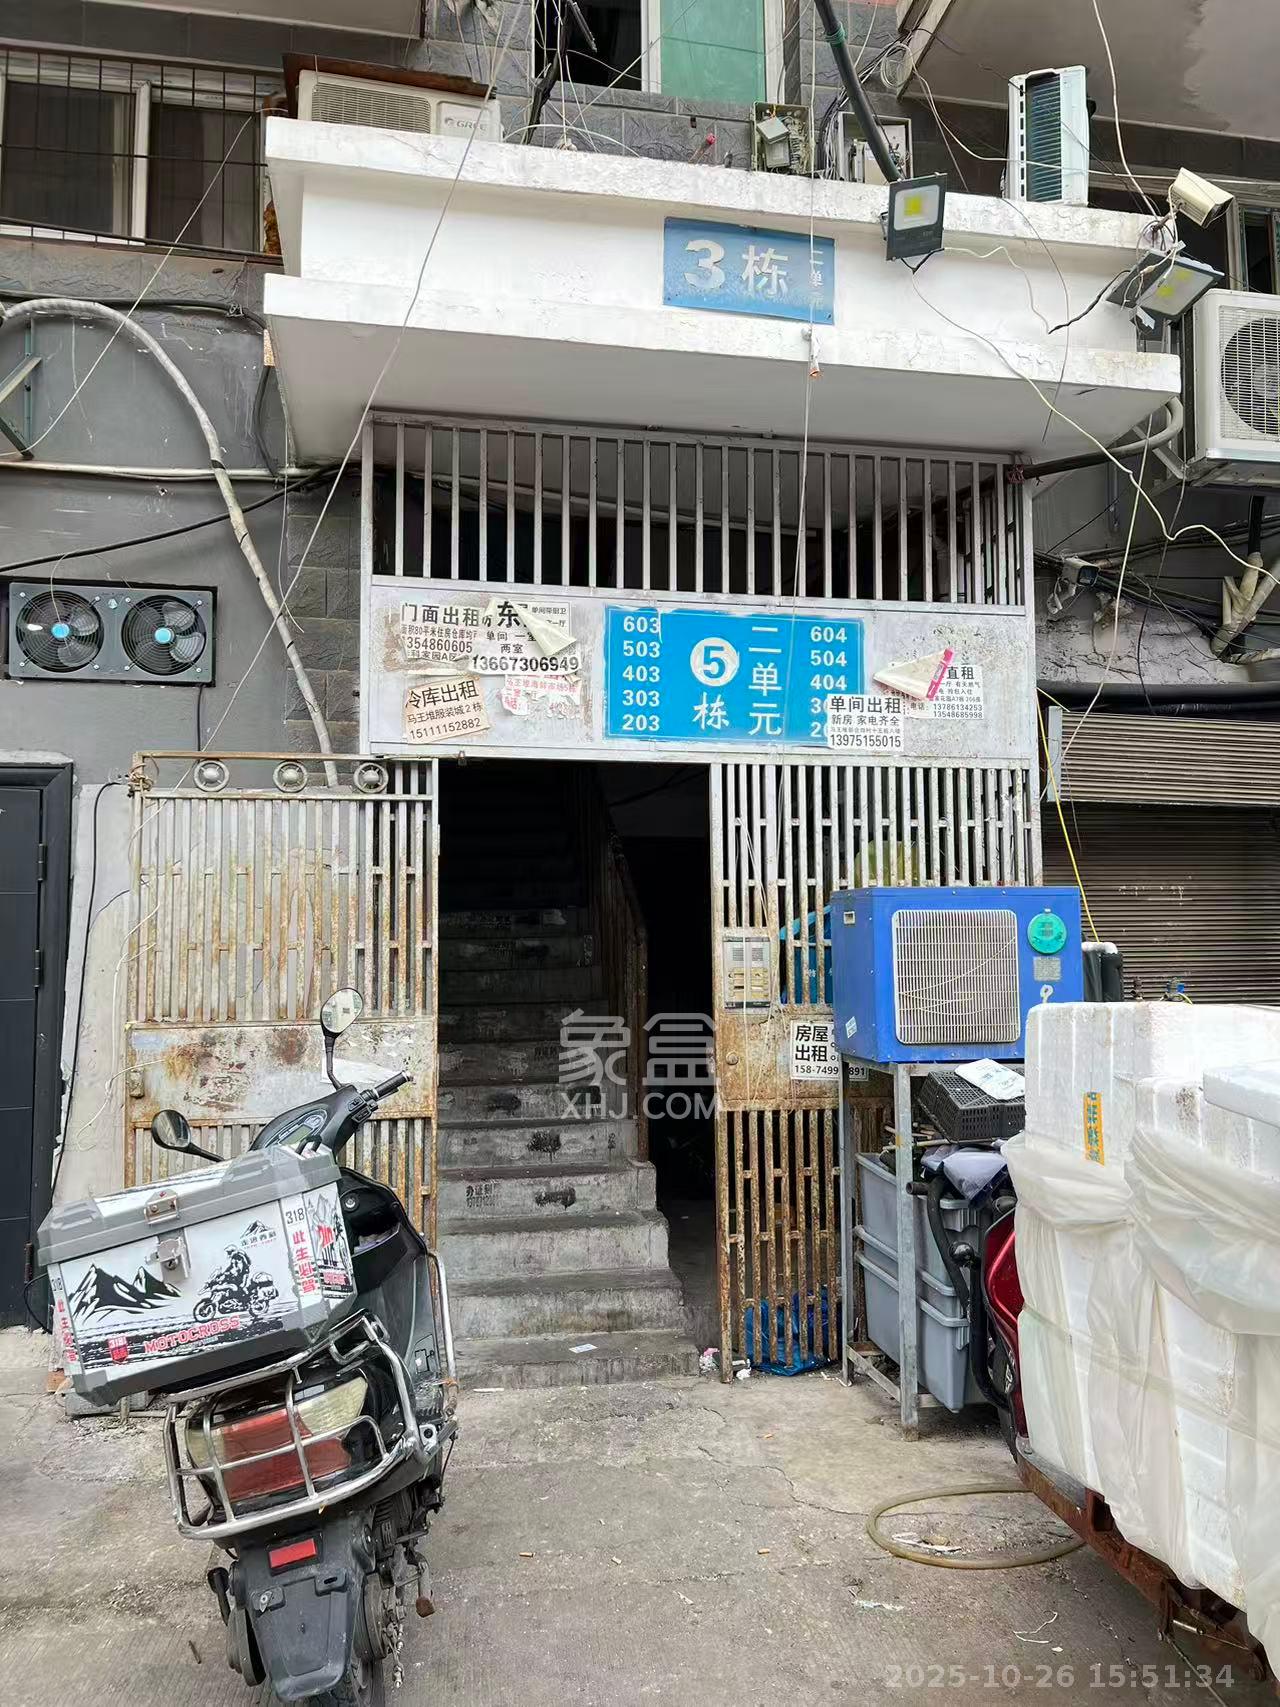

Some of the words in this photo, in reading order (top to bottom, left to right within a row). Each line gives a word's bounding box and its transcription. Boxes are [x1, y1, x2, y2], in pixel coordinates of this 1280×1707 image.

[401, 602, 479, 627] 门面出租
[622, 615, 660, 633] 603
[810, 626, 848, 644] 604
[622, 640, 661, 658] 503
[472, 655, 580, 672] 13667306949
[810, 650, 848, 667] 504
[622, 664, 660, 683] 403
[748, 625, 783, 736] 二单元
[810, 674, 848, 691] 404
[405, 680, 479, 709] 冷库出租
[622, 689, 660, 707] 303
[829, 696, 901, 714] 单间出租
[409, 717, 481, 740] 15111152882
[622, 713, 660, 732] 203
[831, 714, 852, 726] 新房
[856, 715, 899, 727] 家电齐全
[830, 734, 901, 748] 13975155015
[795, 1025, 829, 1042] 房屋
[795, 1045, 829, 1062] 出租
[285, 1207, 305, 1225] 318
[143, 1315, 241, 1353] MOTOCROSS
